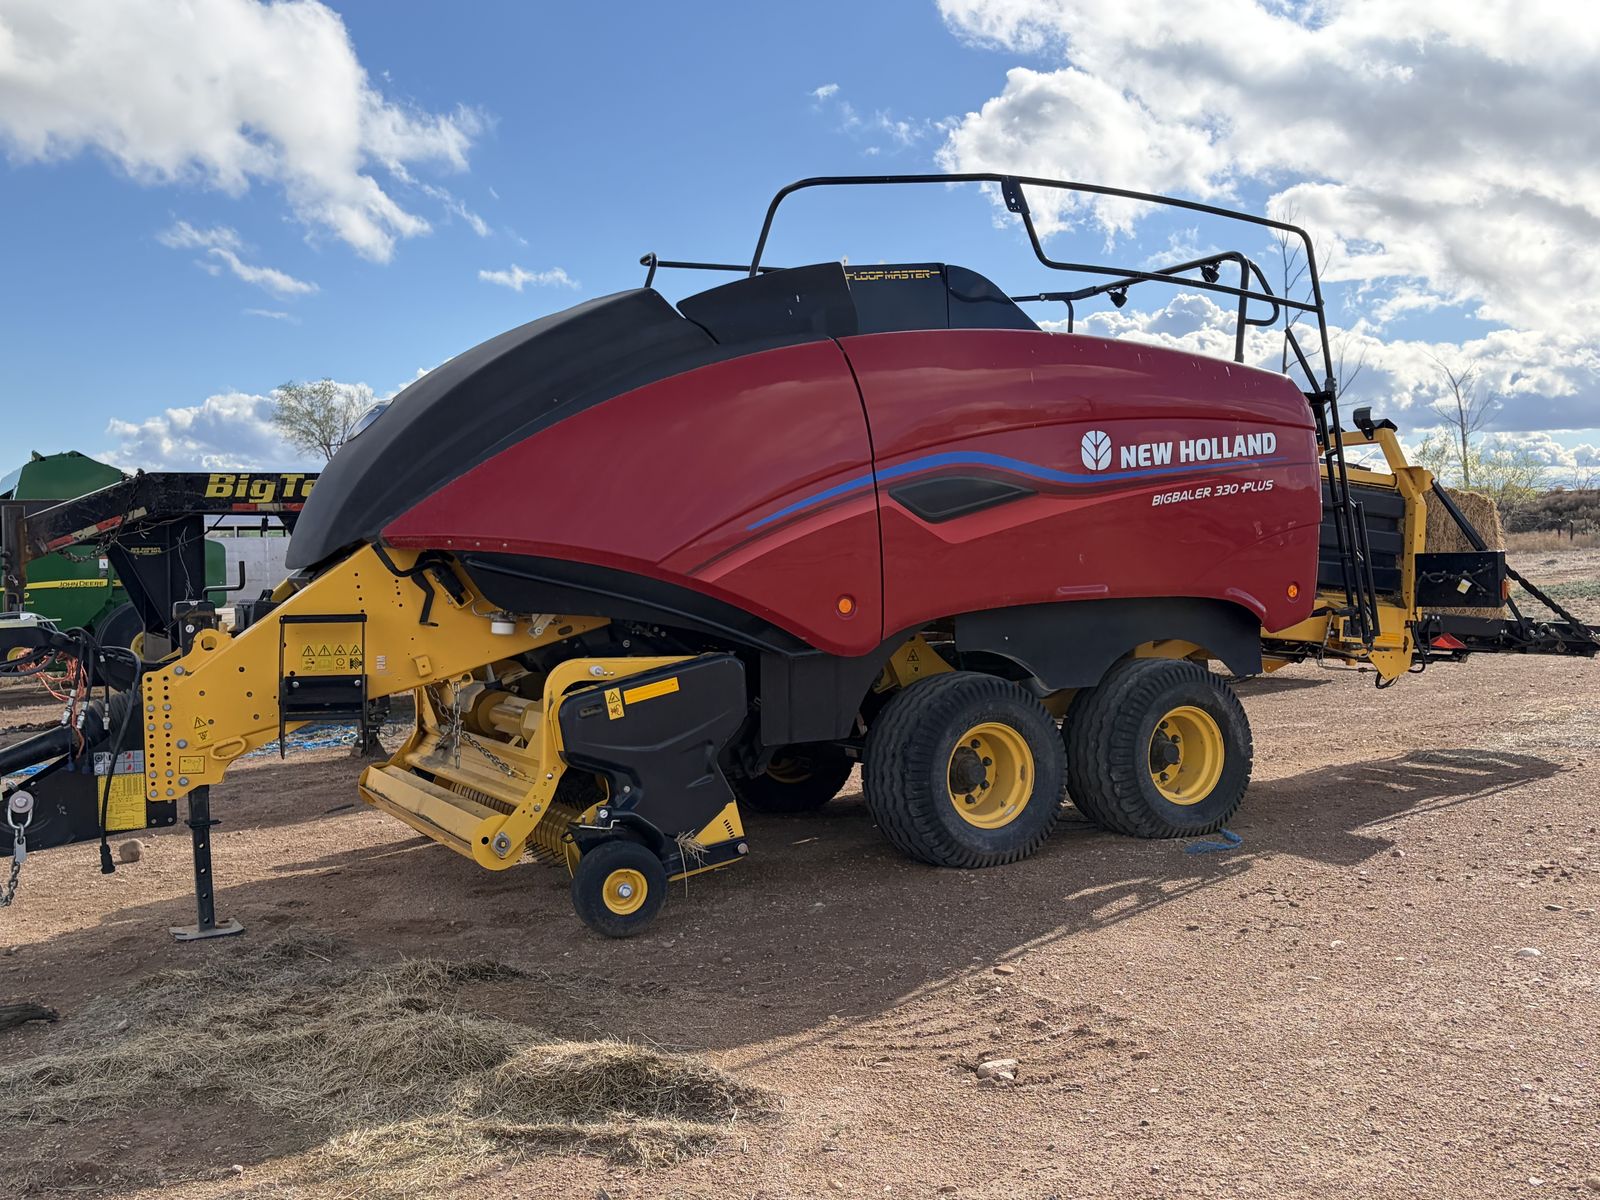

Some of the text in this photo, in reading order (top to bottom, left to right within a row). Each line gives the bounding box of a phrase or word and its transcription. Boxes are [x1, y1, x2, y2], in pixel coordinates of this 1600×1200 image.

[1120, 432, 1277, 469] NEW HOLLAND
[1151, 487, 1212, 507] BIGBALER
[1214, 484, 1240, 497] 330
